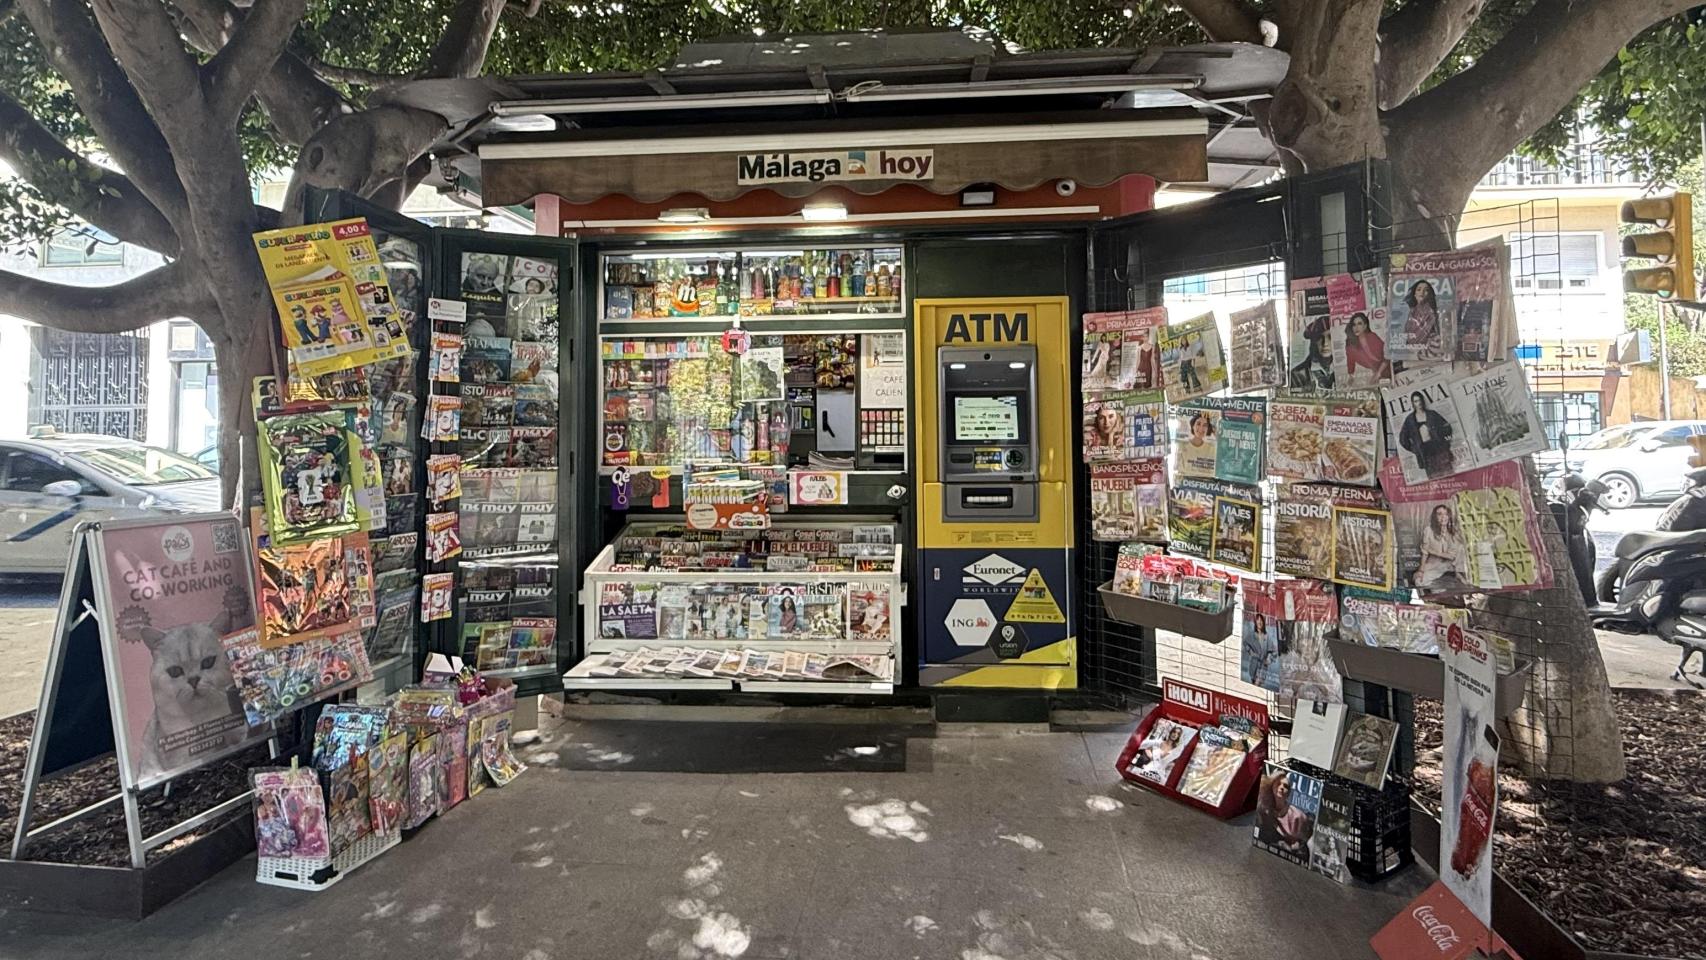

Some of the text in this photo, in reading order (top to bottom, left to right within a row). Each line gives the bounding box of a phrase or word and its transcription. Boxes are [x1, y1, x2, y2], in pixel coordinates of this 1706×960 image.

[738, 150, 933, 181] Málaga hoy
[1405, 261, 1445, 272] NOVELA
[944, 313, 1028, 343] ATM
[1106, 318, 1152, 329] PRIMAVERA
[1462, 374, 1508, 396] Living
[875, 388, 903, 397] CALIEN
[1346, 391, 1377, 400] MESA
[1386, 382, 1449, 417] TEVA
[1271, 404, 1308, 415] SABER
[1270, 413, 1320, 424] COCINAR
[1327, 419, 1373, 429] EMPANADAS
[1331, 426, 1374, 435] HOJALDRES
[1102, 479, 1133, 491] MUEBLE
[1292, 485, 1330, 497] ROMA
[1173, 489, 1214, 505] VIAJES
[482, 503, 517, 514] muy
[521, 503, 555, 513] muy
[1222, 504, 1251, 518] VIAJES
[1275, 502, 1332, 519] HISTORIA
[1342, 516, 1381, 529] HISTORIA
[517, 543, 551, 553] muy
[1170, 540, 1202, 552] VIETNAM
[1218, 551, 1248, 564] FRANCIA
[123, 557, 232, 585] CAT CAFÉ AND
[973, 563, 1016, 575] Euronet
[1349, 566, 1370, 575] ROMA
[130, 573, 233, 602] CO-WORKING
[515, 587, 553, 597] muy
[469, 592, 506, 603] muy
[601, 604, 653, 616] LA SAETA
[952, 618, 974, 628] ING
[1463, 635, 1481, 649] COLD
[1463, 643, 1488, 661] DRINKS
[1167, 683, 1209, 709] ¡HOLA!
[1321, 797, 1348, 816] VOGUE
[1412, 905, 1461, 951] Coca-Cola
